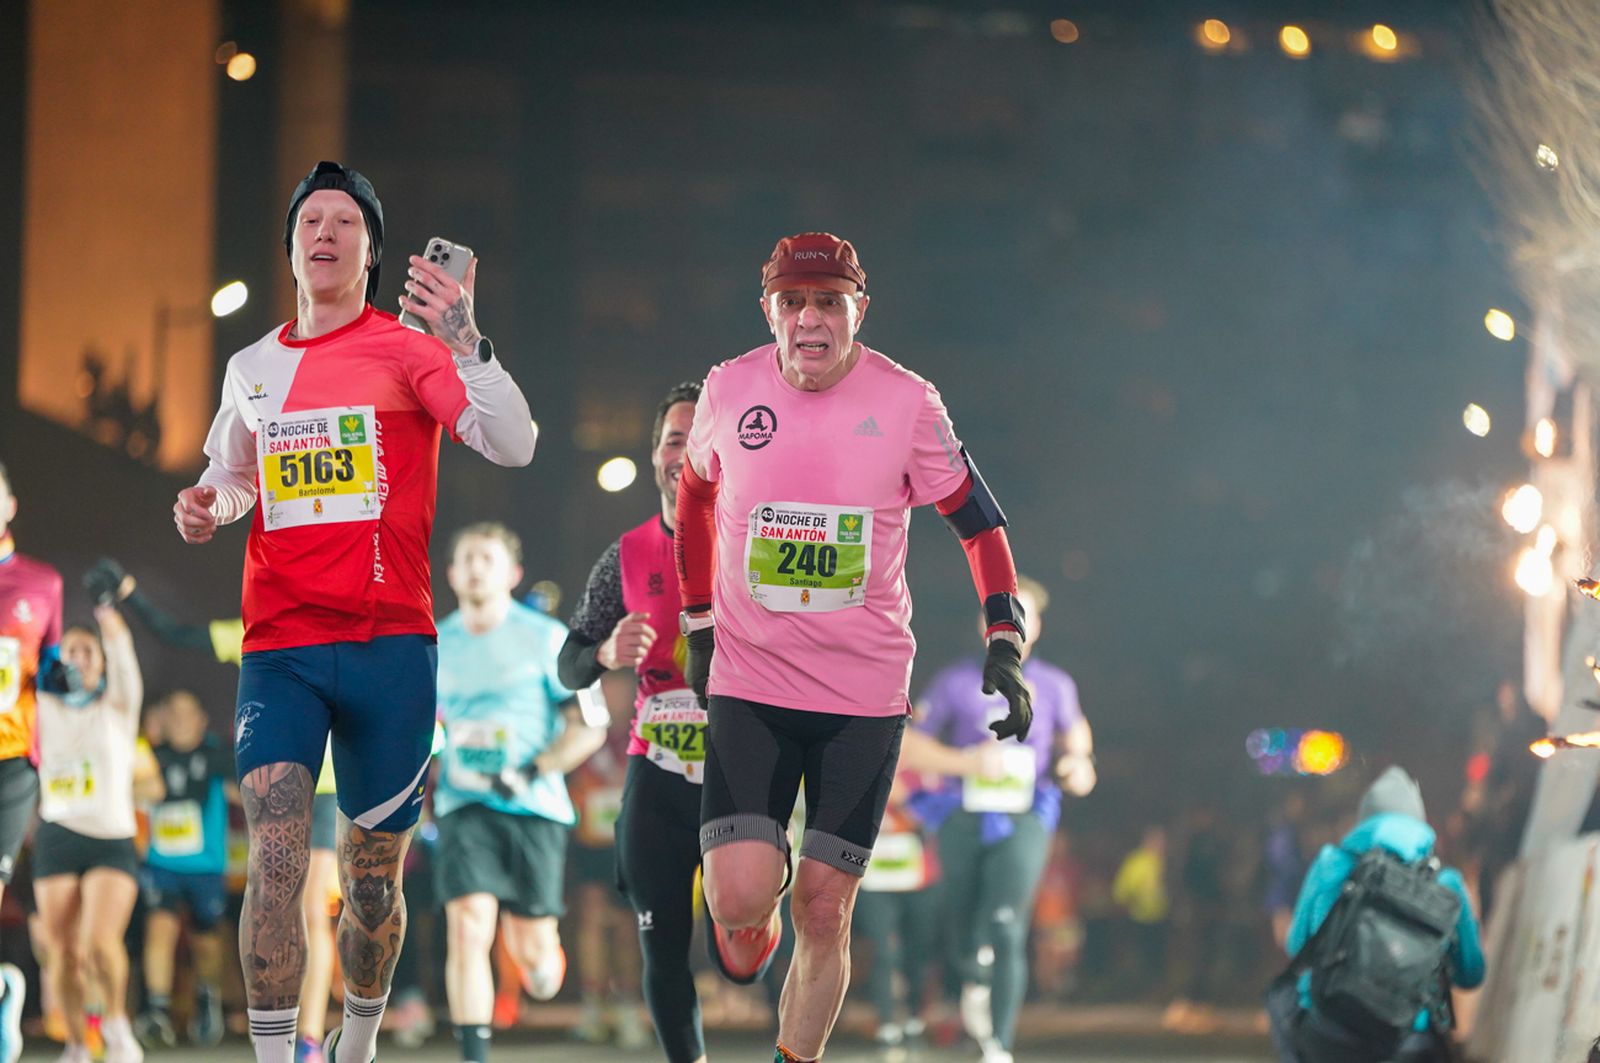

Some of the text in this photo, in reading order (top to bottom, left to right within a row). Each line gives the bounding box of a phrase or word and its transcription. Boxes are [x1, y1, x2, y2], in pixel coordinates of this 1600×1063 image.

[794, 250, 817, 260] RUN
[281, 423, 315, 437] NOCHE
[317, 422, 329, 433] DE
[738, 432, 773, 441] MAPOMA
[269, 440, 290, 454] SAN
[293, 434, 331, 451] ANTÓN
[280, 449, 354, 488] 5163
[298, 487, 336, 497] Bartolomé
[775, 514, 811, 526] NOCHE
[813, 517, 828, 528] DE
[760, 526, 783, 539] SAN
[785, 527, 827, 542] ANTÓN
[777, 542, 838, 578] 240
[790, 578, 823, 588] Santiago
[664, 700, 690, 709] NOCHE
[651, 713, 668, 722] SAN
